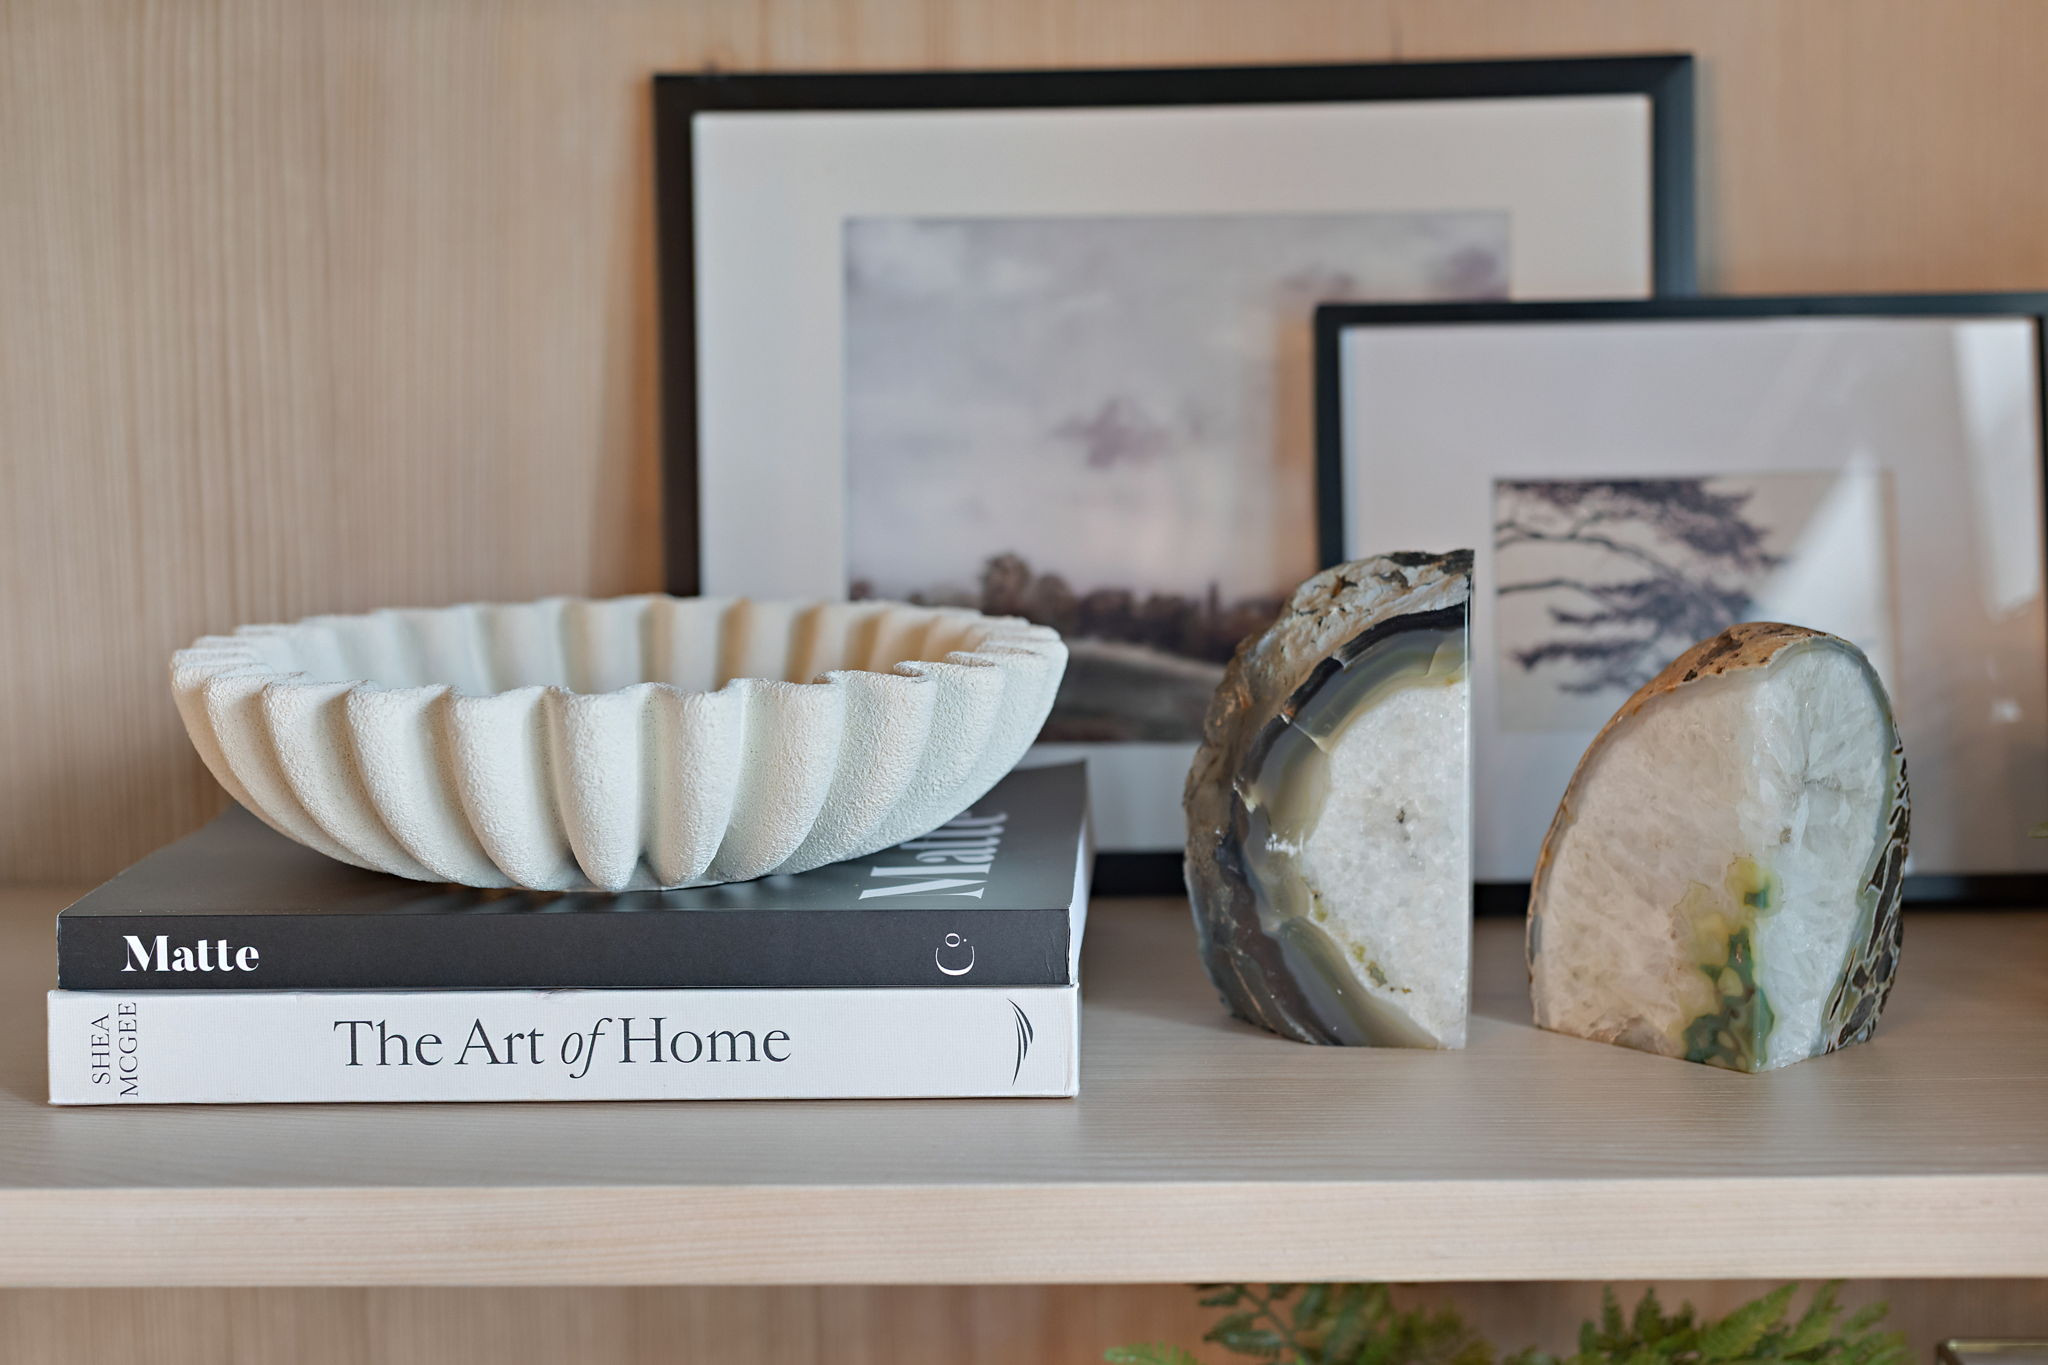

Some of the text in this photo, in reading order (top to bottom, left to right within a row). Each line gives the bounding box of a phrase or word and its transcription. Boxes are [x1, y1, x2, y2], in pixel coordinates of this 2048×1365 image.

[120, 935, 260, 972] Matte
[91, 1013, 111, 1085] SHEA
[118, 1002, 139, 1097] MCGEE
[333, 1017, 791, 1079] The Art of Home
